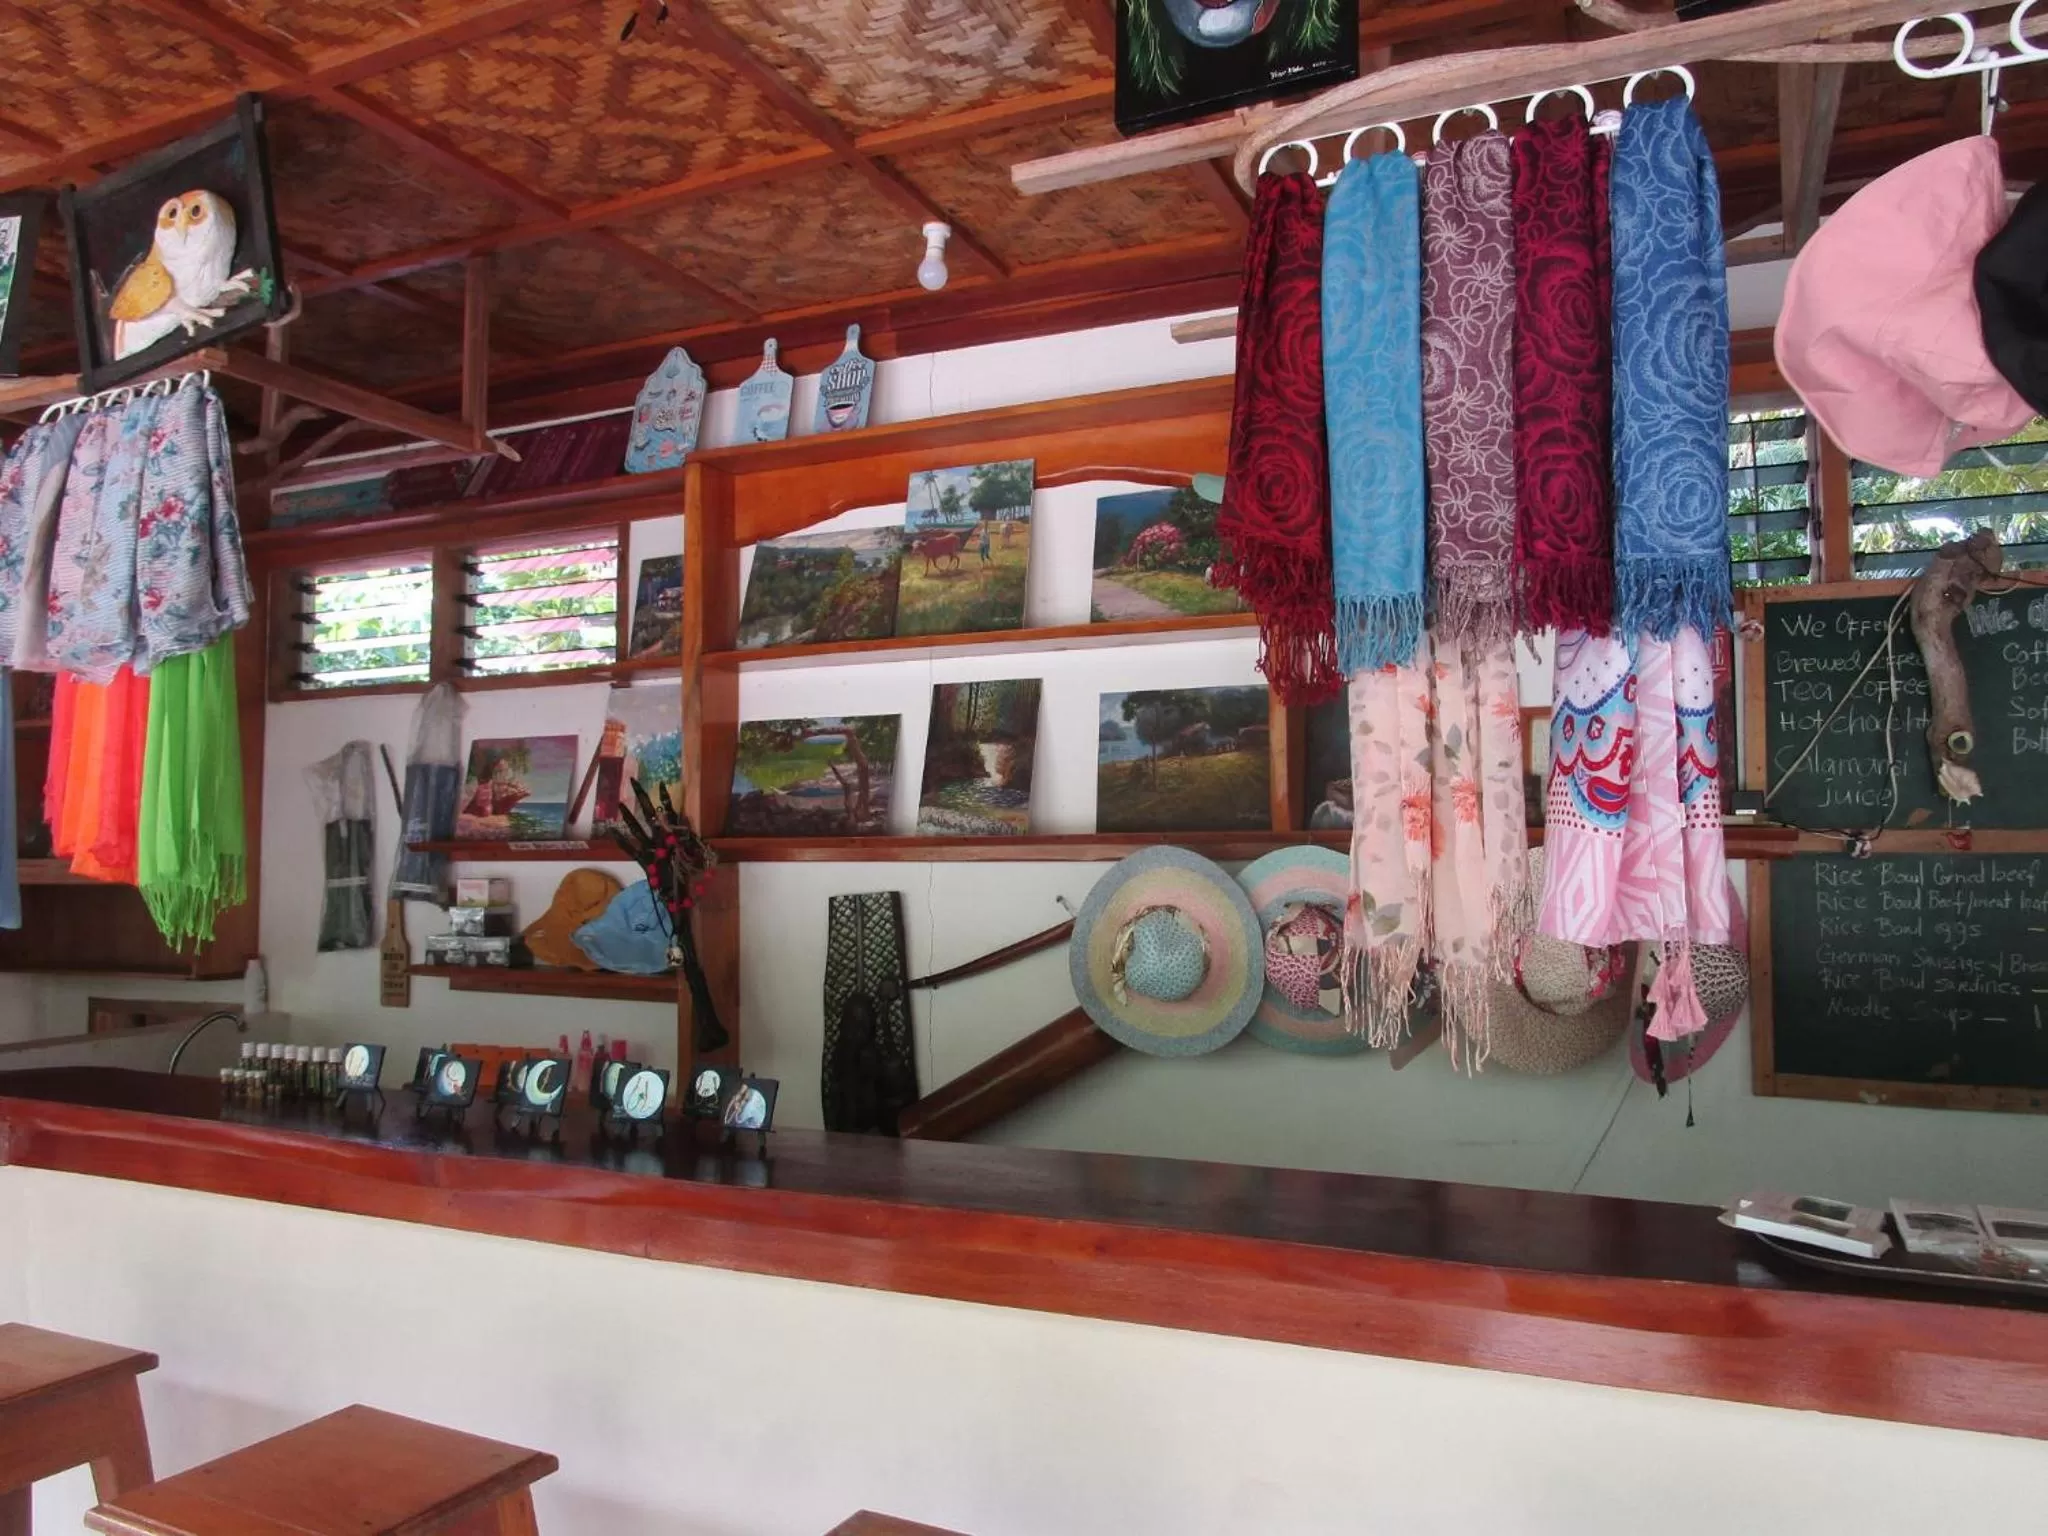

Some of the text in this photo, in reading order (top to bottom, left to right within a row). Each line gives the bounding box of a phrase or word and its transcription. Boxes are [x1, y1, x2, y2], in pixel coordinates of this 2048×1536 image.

[1781, 613, 1826, 638] We
[1775, 650, 1862, 674] Brewed
[1773, 679, 1832, 703] Tea
[1780, 709, 1824, 732] Hot
[1815, 860, 1864, 886] Rice
[1817, 889, 1867, 912] Rice
[1818, 917, 1862, 941] Rice
